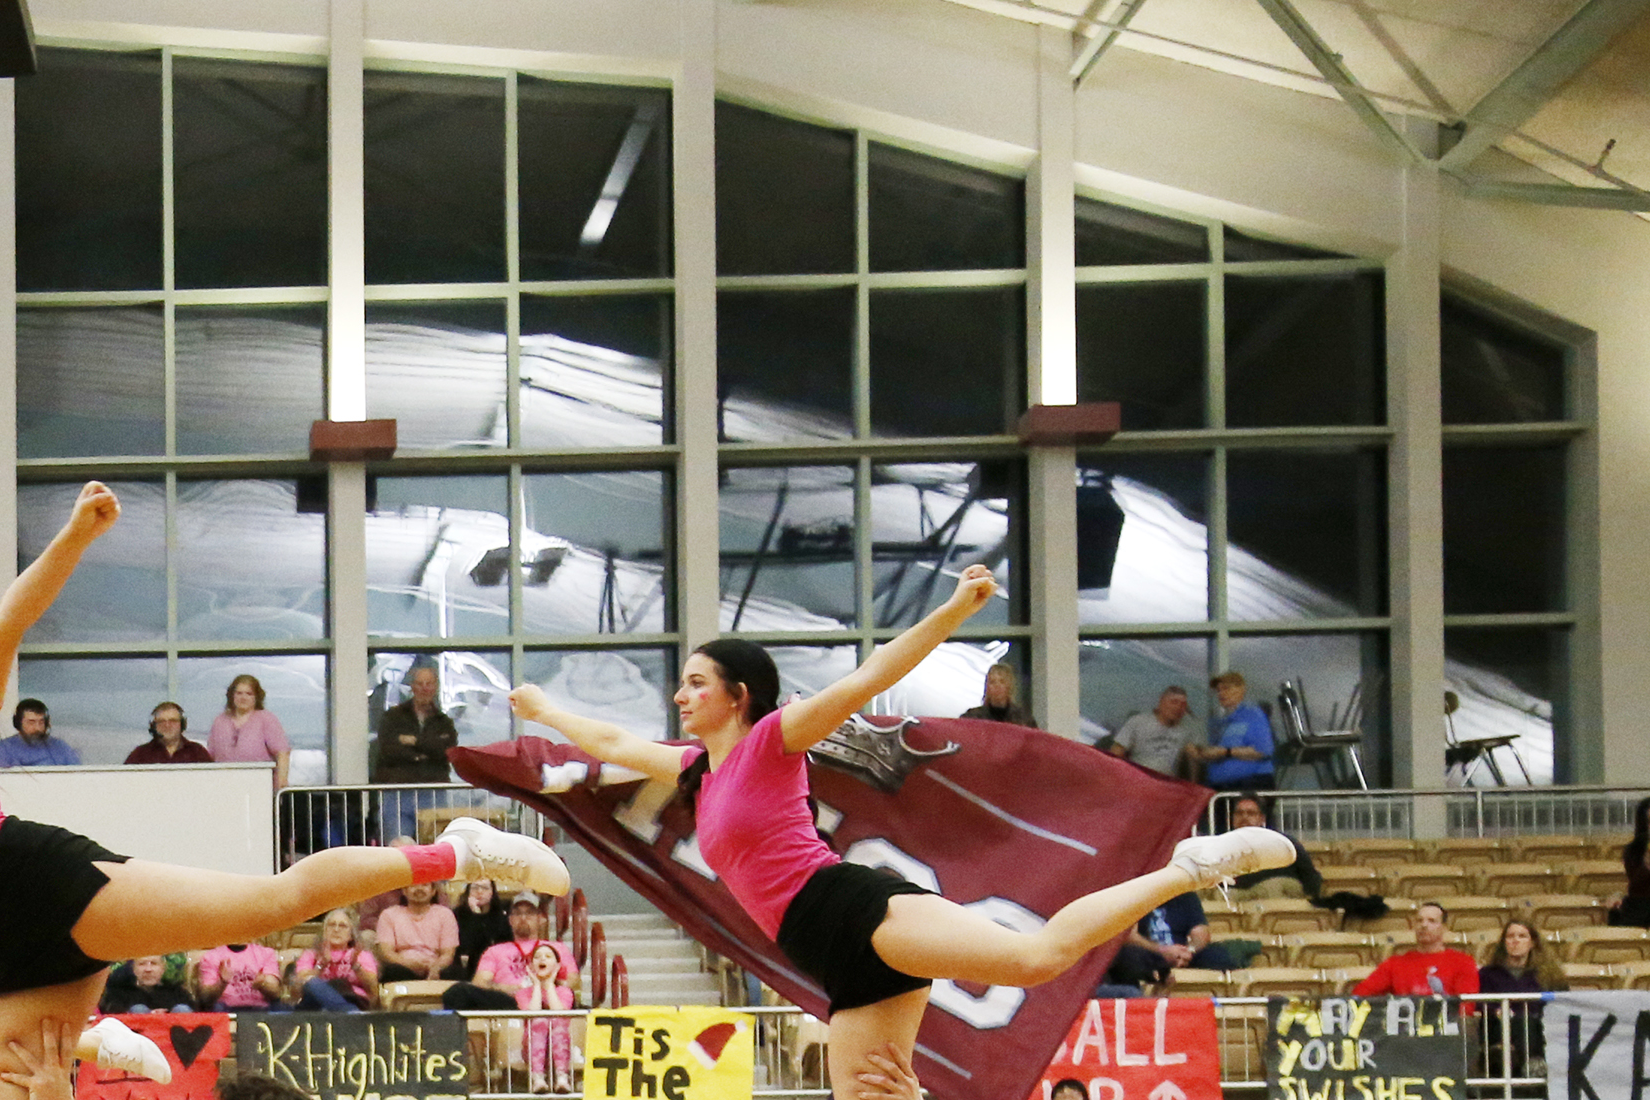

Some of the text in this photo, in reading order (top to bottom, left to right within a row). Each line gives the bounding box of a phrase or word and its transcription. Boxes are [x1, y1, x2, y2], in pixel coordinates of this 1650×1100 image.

[1051, 998, 1188, 1067] ALL
[1384, 997, 1460, 1037] ALL
[595, 1016, 670, 1061] Tis
[1277, 1038, 1377, 1077] YOUR
